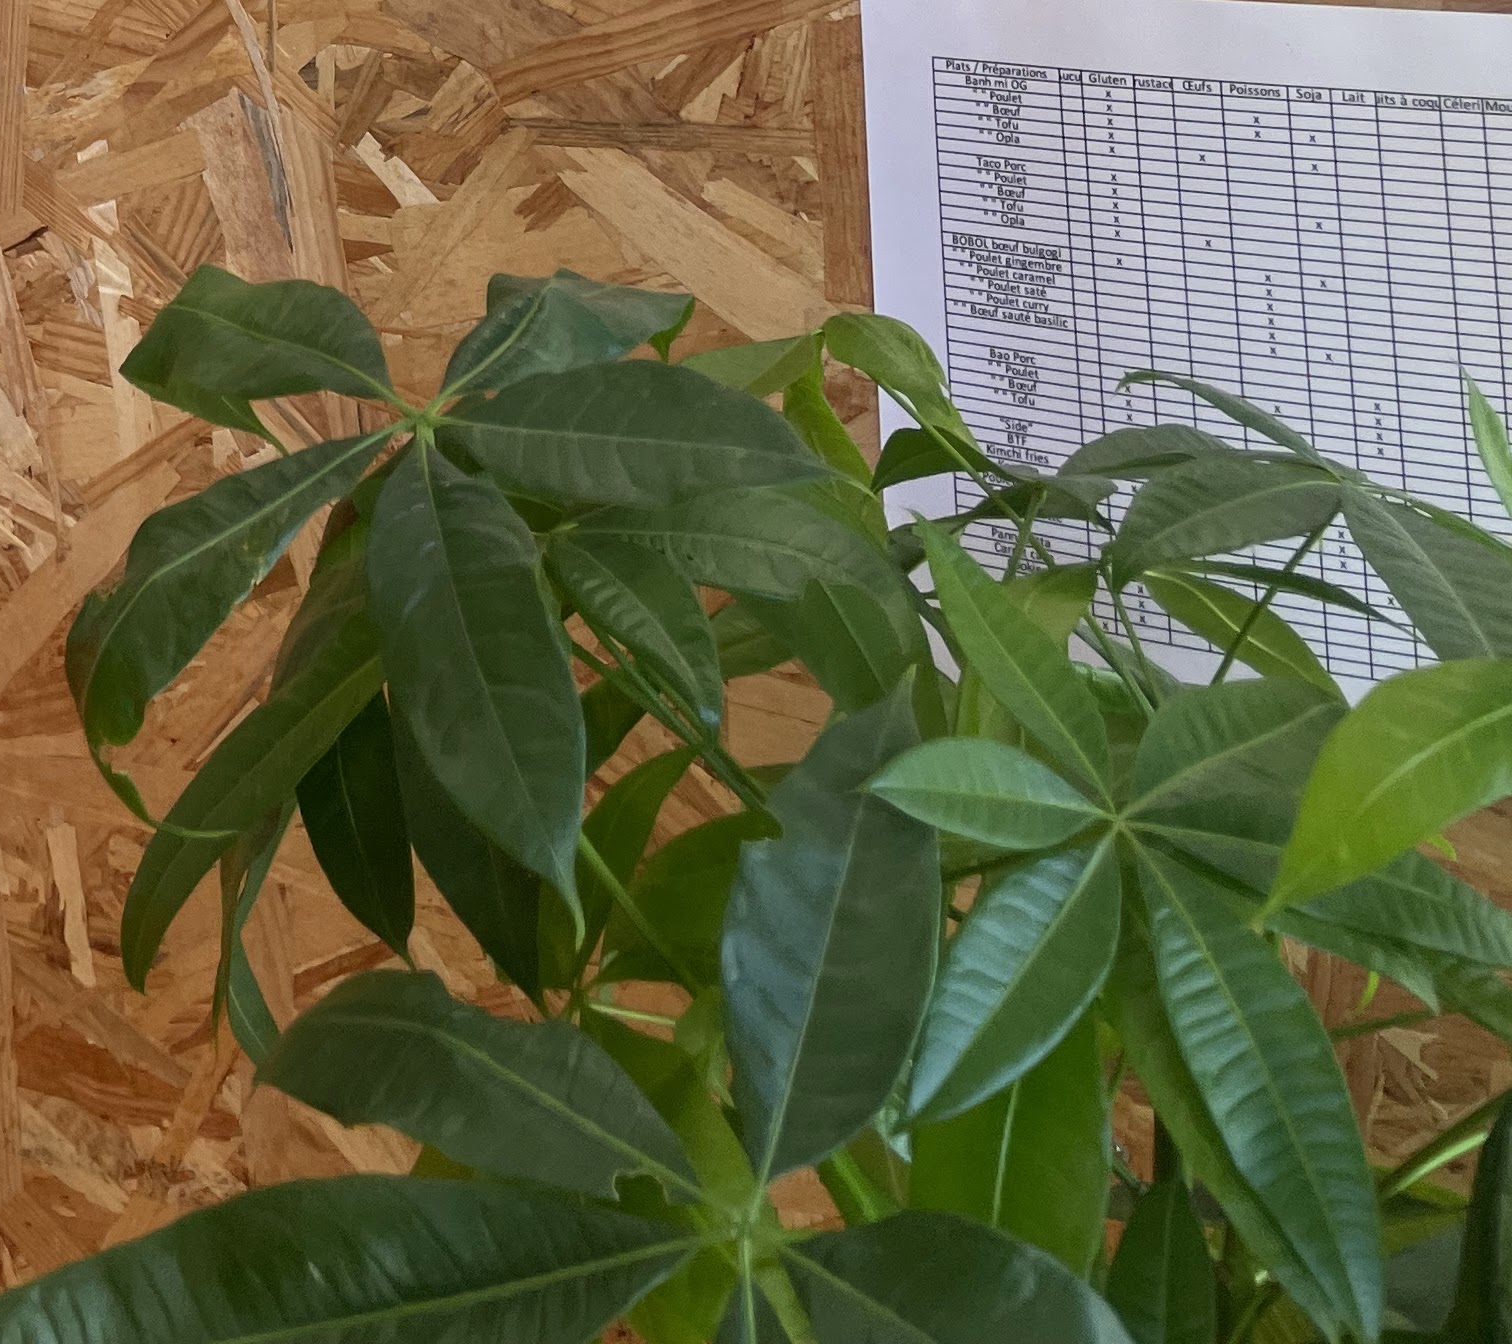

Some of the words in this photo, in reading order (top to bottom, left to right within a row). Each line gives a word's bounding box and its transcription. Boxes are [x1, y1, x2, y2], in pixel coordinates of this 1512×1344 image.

[946, 60, 971, 72] Plats
[974, 62, 979, 74] /
[982, 64, 1046, 79] Préparations
[965, 75, 990, 87] Banh
[994, 78, 1008, 88] mi
[1011, 80, 1027, 90] OG
[1089, 74, 1126, 86] Gluten
[1182, 82, 1212, 92] Œufs
[1230, 84, 1280, 98] Poissons
[1296, 89, 1322, 102] Soja
[1342, 92, 1365, 103] Lait
[1444, 99, 1481, 111] Céleri
